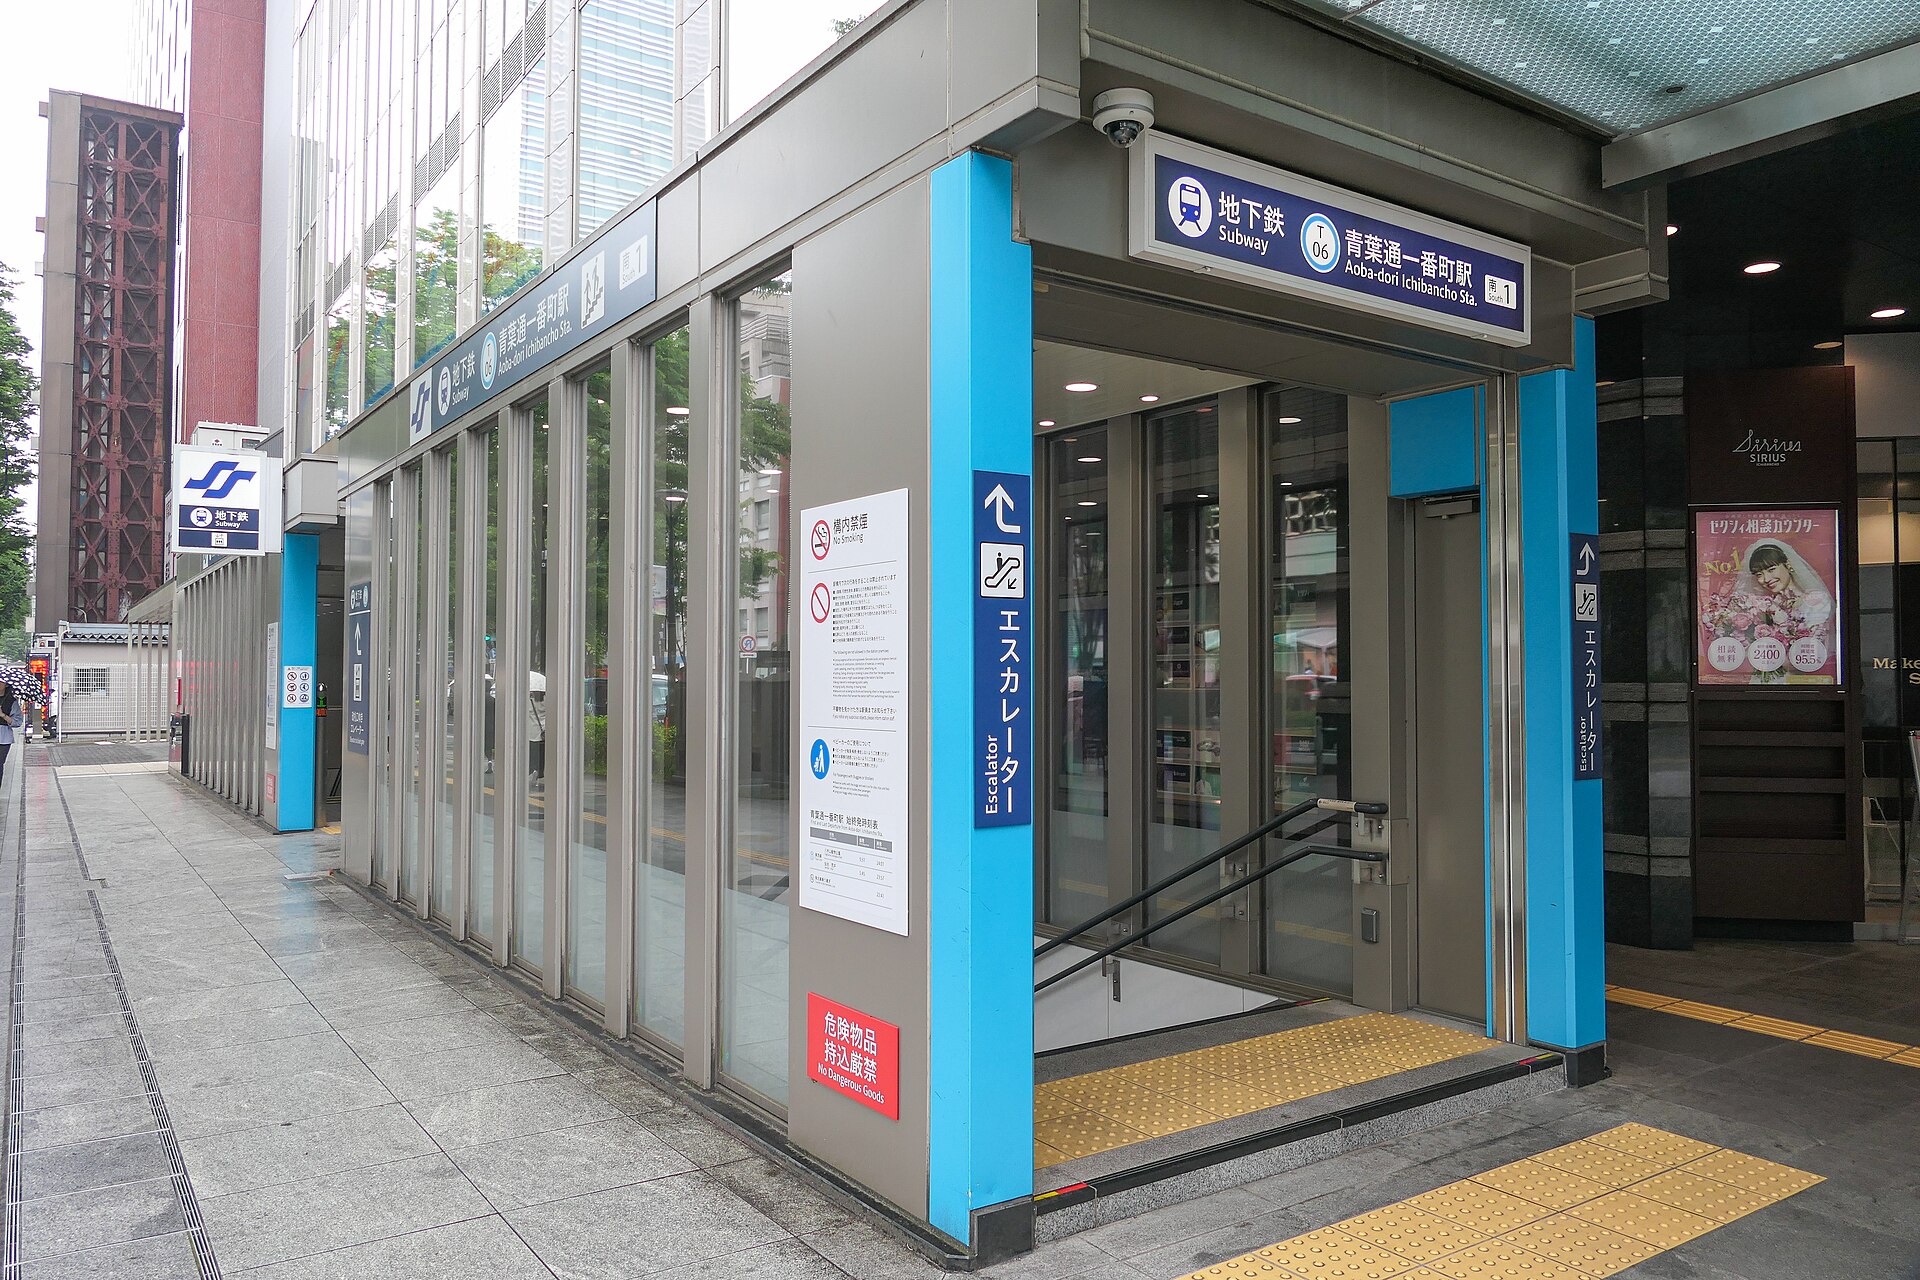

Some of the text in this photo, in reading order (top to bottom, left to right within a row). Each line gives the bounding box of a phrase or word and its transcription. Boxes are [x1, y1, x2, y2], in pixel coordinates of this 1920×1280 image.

[1218, 191, 1285, 238] 地下鉄
[1218, 225, 1269, 255] Subway
[1316, 225, 1325, 238] T
[636, 244, 641, 273] 1
[1312, 240, 1329, 260] 06
[1344, 229, 1473, 289] 青葉通一番町駅
[1344, 263, 1478, 307] Aoba-dori Ichibancho Sta.
[1487, 277, 1511, 305] 南 1
[1488, 291, 1504, 304] South
[498, 283, 570, 358] 青葉通一番町駅
[498, 320, 573, 376] Aoba-dori Ichibancho Sta.
[452, 350, 476, 386] 地下鉄
[484, 360, 493, 377] 06
[452, 385, 470, 405] Subway
[1749, 453, 1786, 463] SIRIUS
[215, 510, 249, 522] 地下鉄
[215, 521, 240, 529] Subway
[833, 513, 868, 535] 構内禁煙
[1710, 518, 1820, 534] ゼクシィ相談カウンター
[833, 533, 863, 545] No Smoking
[1753, 649, 1780, 660] 2400
[999, 610, 1020, 813] エスカレーター
[1585, 630, 1596, 770] エスカレーター
[985, 734, 998, 814] Escalator
[824, 1011, 877, 1056] 危険物品
[824, 1038, 877, 1084] 持込厳禁
[818, 1062, 885, 1104] No Dangerous Goods
